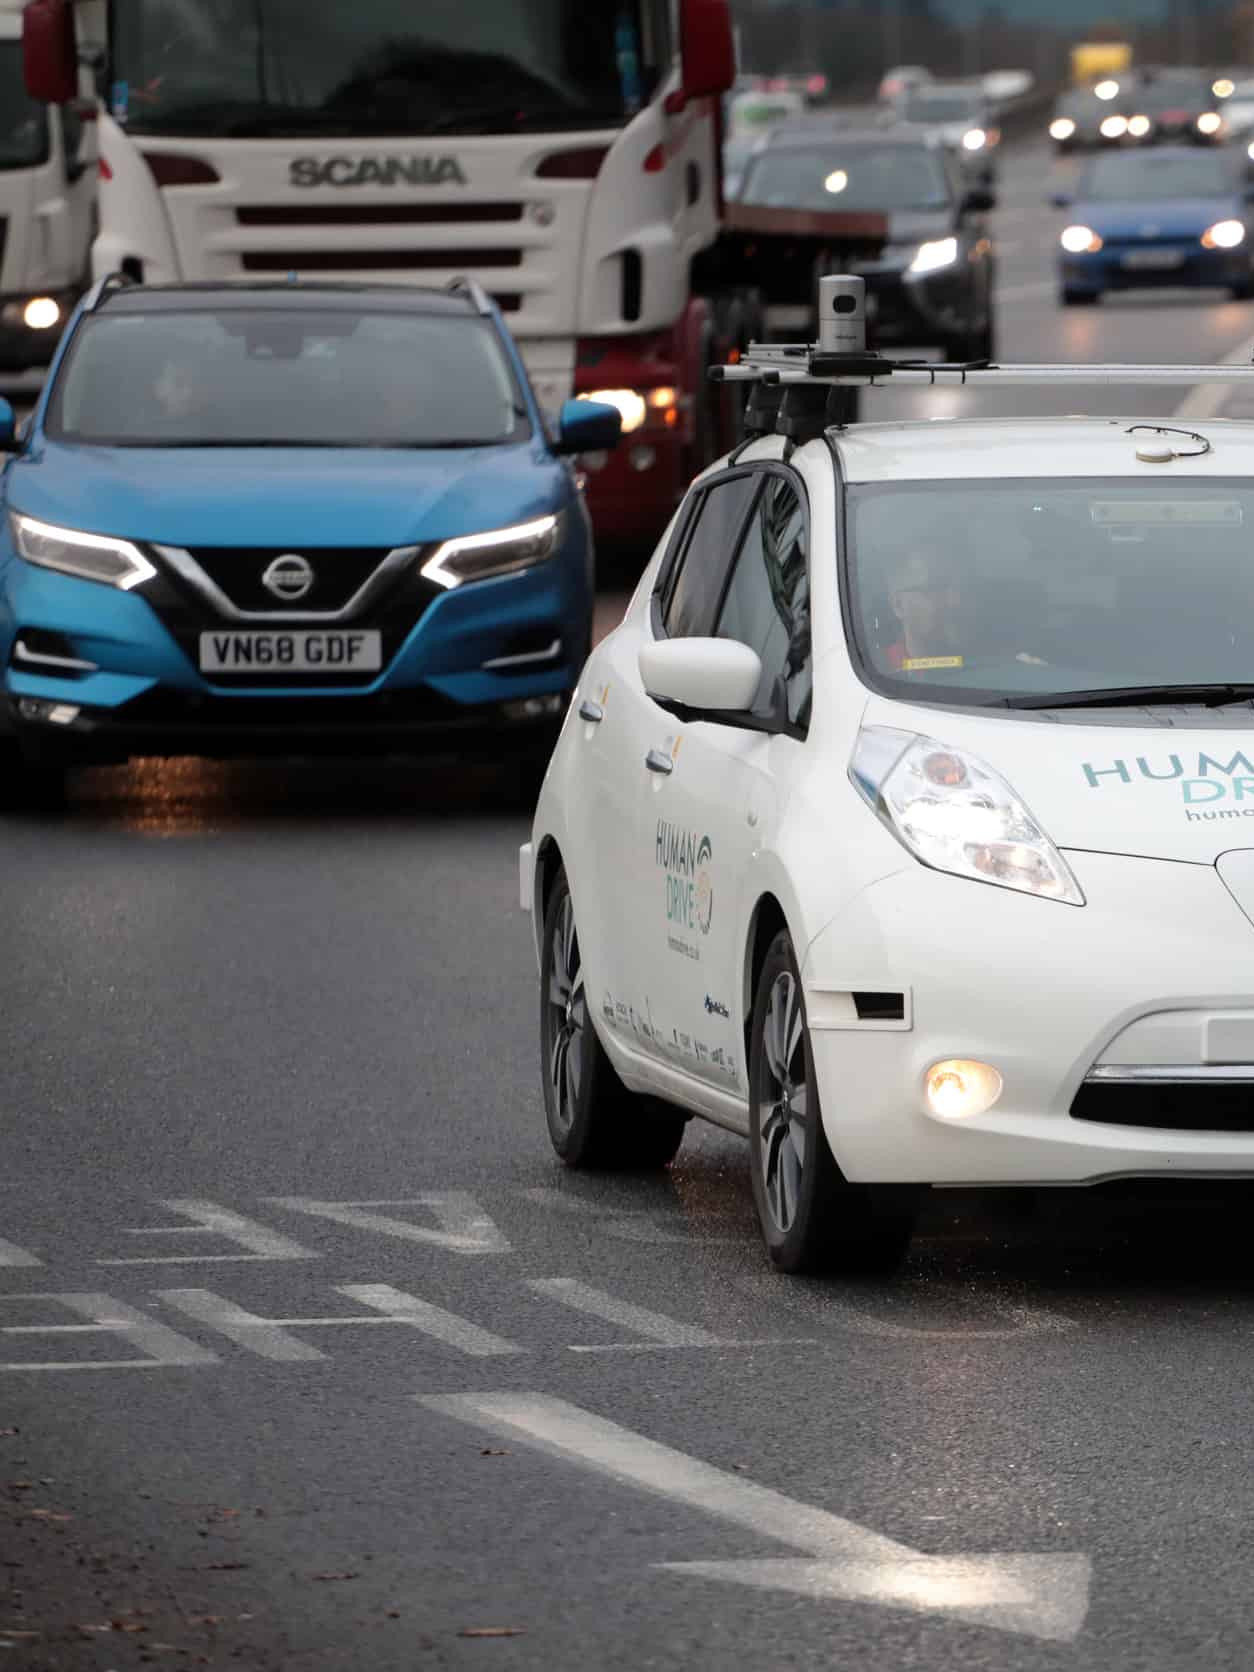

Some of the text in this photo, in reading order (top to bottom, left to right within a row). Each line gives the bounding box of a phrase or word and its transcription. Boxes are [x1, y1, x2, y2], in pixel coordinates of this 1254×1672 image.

[288, 155, 468, 187] SCANIA
[213, 636, 365, 665] VN68 GDF
[656, 818, 697, 880] HUMAN
[666, 873, 695, 929] DRIVE
